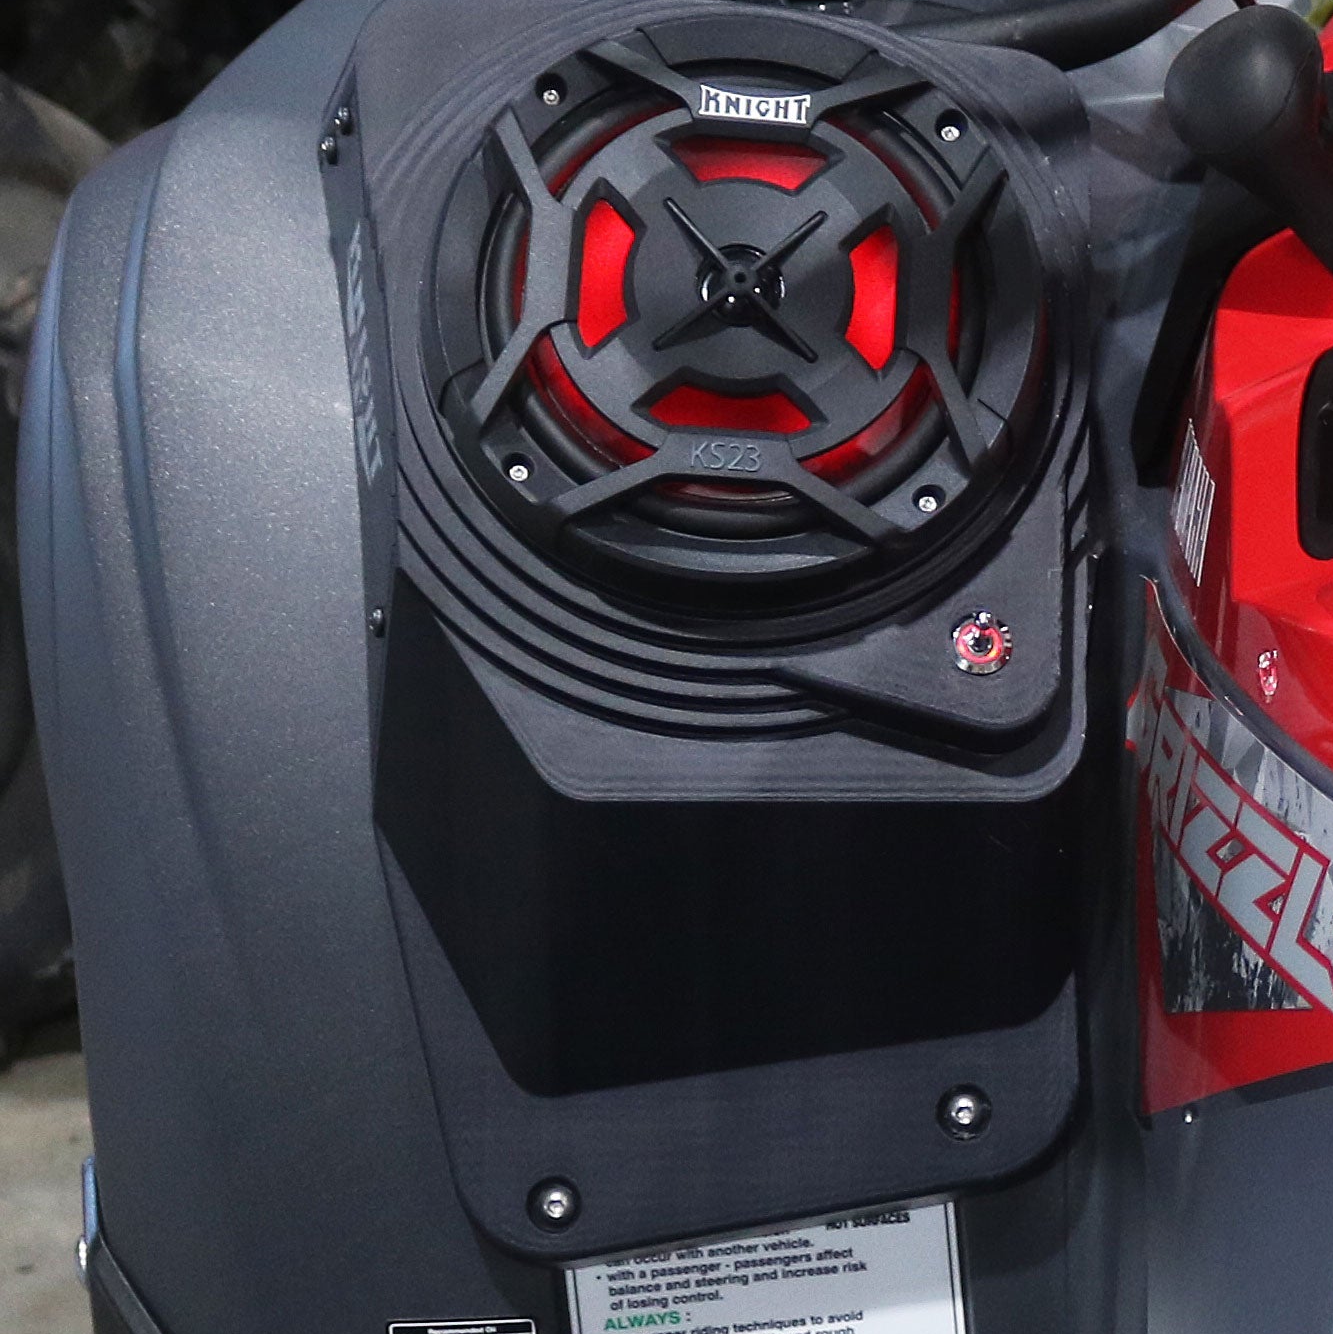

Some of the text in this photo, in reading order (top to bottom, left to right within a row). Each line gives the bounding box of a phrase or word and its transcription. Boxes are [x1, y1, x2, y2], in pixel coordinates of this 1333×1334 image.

[703, 87, 807, 121] KNIGHT
[690, 441, 761, 472] KS23
[676, 1250, 703, 1259] with
[707, 1244, 758, 1257] another
[761, 1238, 813, 1251] vehicle.
[606, 1248, 852, 1281] with a passenger passengers affect
[608, 1260, 866, 1296] balance and steering and increase risk
[609, 1290, 722, 1310] of losing control.
[604, 1311, 679, 1329] ALWAYS
[732, 1318, 805, 1332] techniques
[810, 1315, 823, 1325] to
[828, 1310, 862, 1323] avoid
